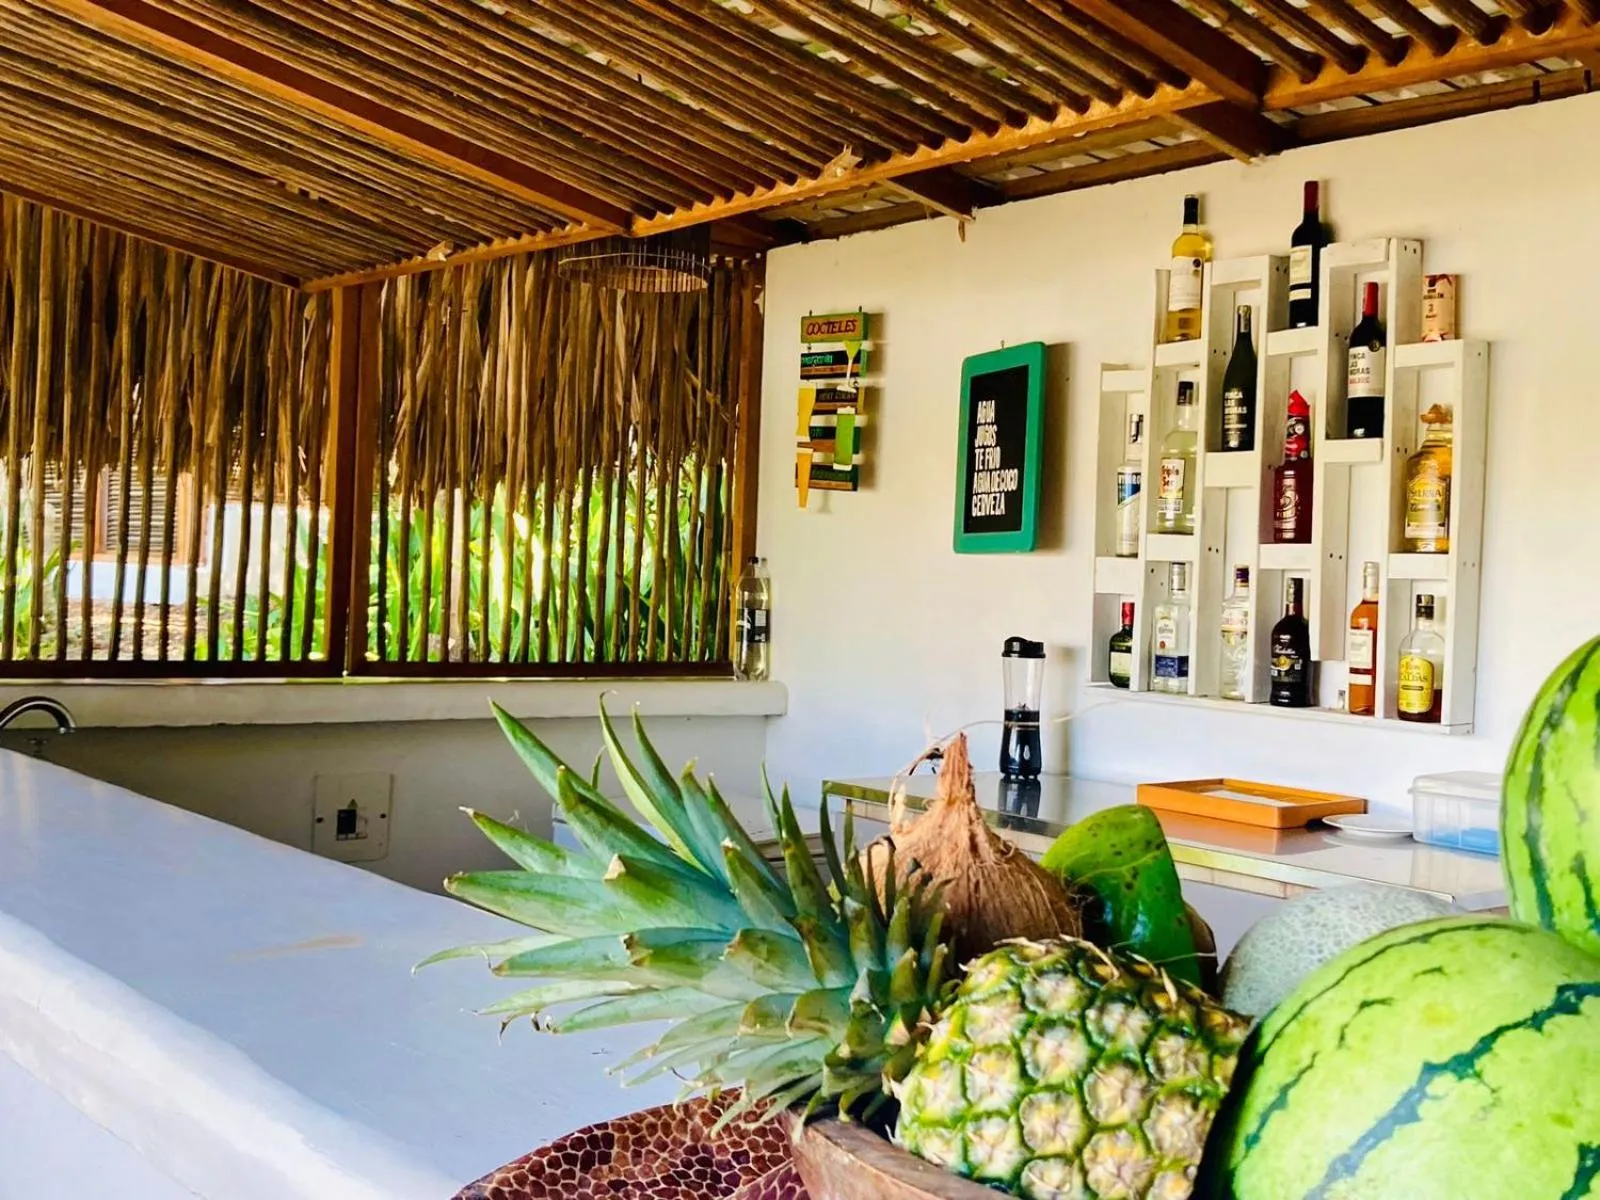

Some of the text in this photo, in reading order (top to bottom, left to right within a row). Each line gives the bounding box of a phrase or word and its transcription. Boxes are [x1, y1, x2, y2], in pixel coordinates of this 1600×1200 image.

[806, 319, 857, 336] COCTELES
[1349, 367, 1371, 376] MORAS
[977, 400, 995, 424] AGUA
[975, 424, 998, 448] JUGOS
[974, 446, 1001, 471] TE FRIO
[971, 492, 1006, 517] CERVEZA
